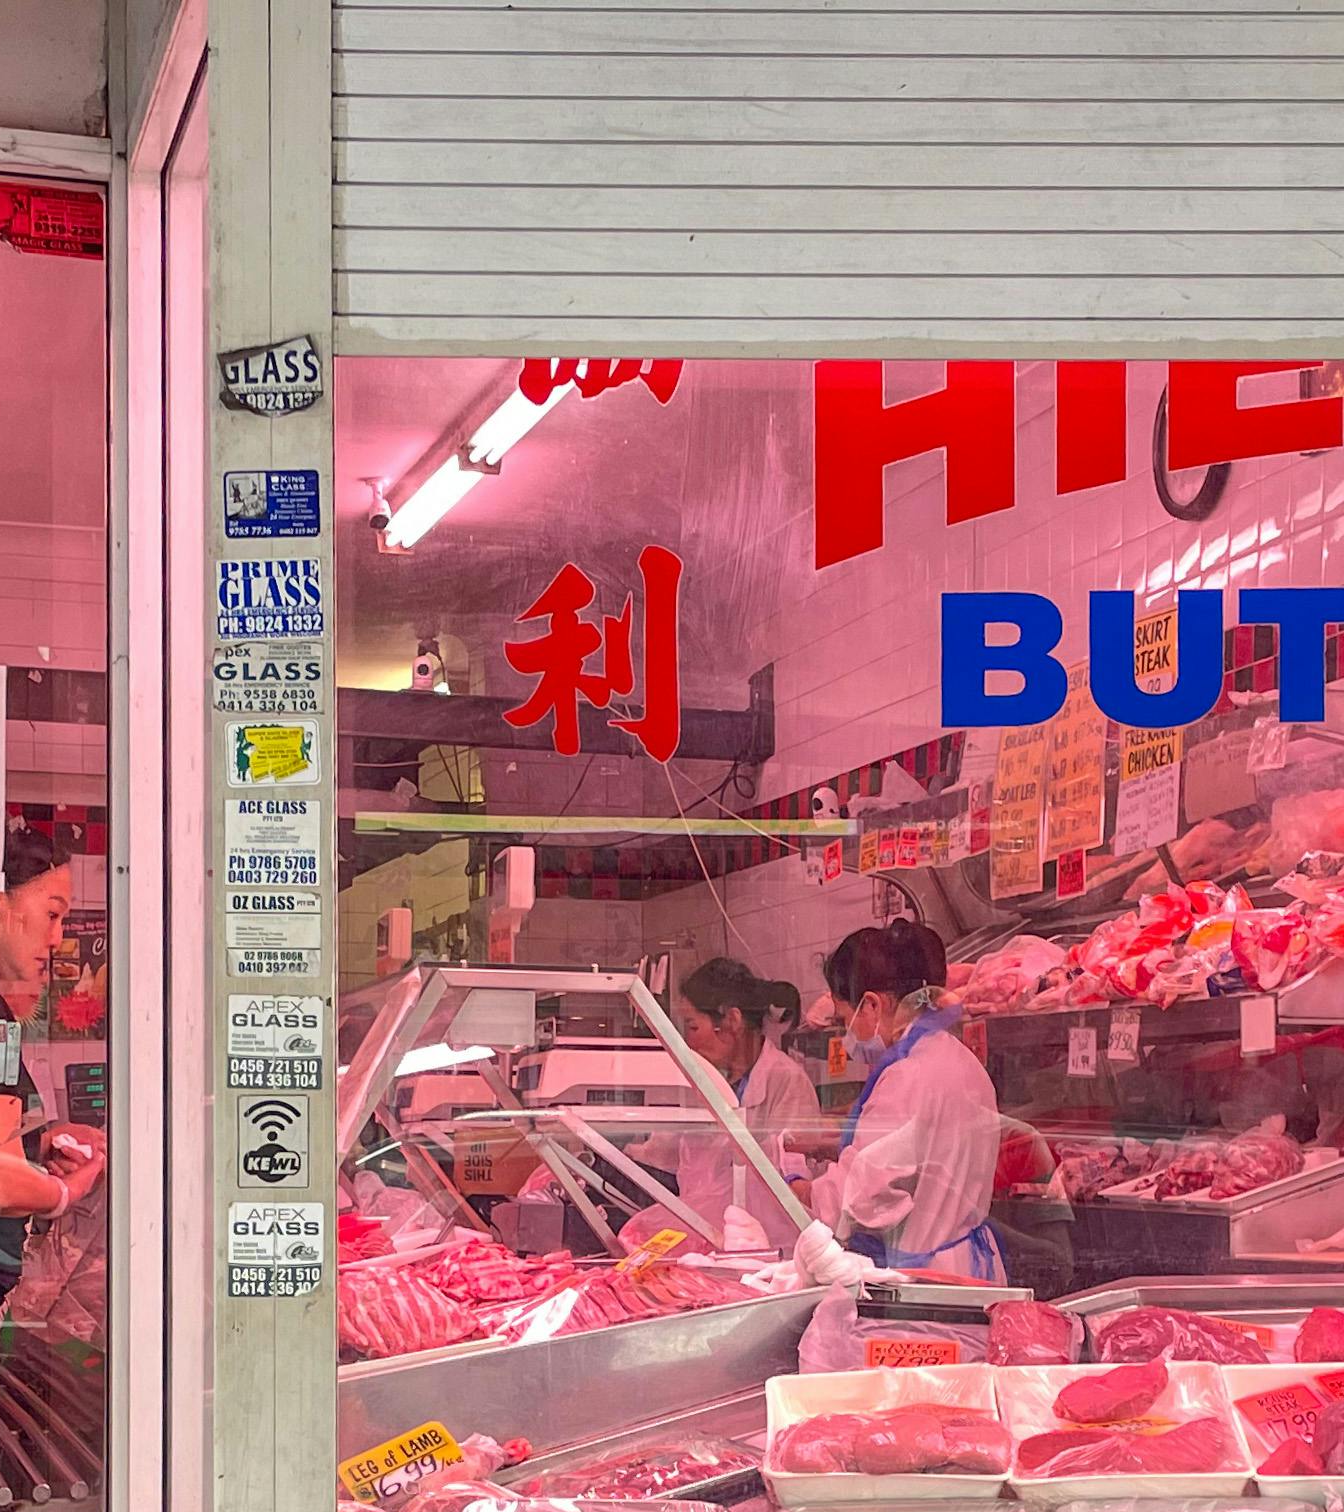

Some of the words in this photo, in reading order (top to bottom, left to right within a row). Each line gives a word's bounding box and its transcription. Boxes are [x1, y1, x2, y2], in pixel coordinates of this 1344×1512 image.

[226, 349, 319, 385] GLASS
[221, 559, 319, 578] PRIME
[219, 576, 321, 609] GLASS
[219, 616, 243, 633] PH:
[245, 616, 284, 633] 9824
[285, 614, 322, 631] 1332
[1136, 615, 1172, 649] SKIRT
[220, 647, 251, 660] pex
[503, 546, 684, 764] 利
[1134, 644, 1170, 676] STEAK
[214, 662, 321, 681] GLASS
[243, 689, 277, 700] 9558
[282, 689, 315, 700] 6830
[291, 700, 318, 711] 104
[1127, 743, 1175, 775] CHICKEN
[239, 800, 263, 814] ACE
[266, 801, 307, 815] GLASS
[229, 855, 246, 869] Ph
[248, 855, 282, 870] 9786
[284, 856, 317, 870] 5708
[228, 870, 262, 884] 0403
[265, 870, 289, 884] 729
[291, 870, 317, 884] 260
[232, 895, 249, 910] OZ
[252, 895, 295, 911] GLASS
[238, 961, 264, 973] 0410
[246, 999, 305, 1014] APEX
[231, 1013, 318, 1029] GLASS
[230, 1059, 265, 1073] 0456
[267, 1060, 291, 1074] 721
[293, 1060, 318, 1074] 510
[230, 1073, 264, 1086] 0414
[265, 1073, 292, 1087] 336
[293, 1073, 318, 1088] 104
[247, 1156, 301, 1172] KEWL
[464, 1155, 493, 1168] SIDE
[464, 1168, 494, 1182] THIS
[247, 1208, 306, 1221] APEX
[233, 1221, 320, 1236] GLASS
[232, 1267, 267, 1282] 0456
[295, 1267, 321, 1281] 510
[232, 1281, 266, 1296] 0414
[347, 1460, 380, 1483] LEG
[384, 1449, 399, 1467] of
[399, 1428, 443, 1459] LAMB
